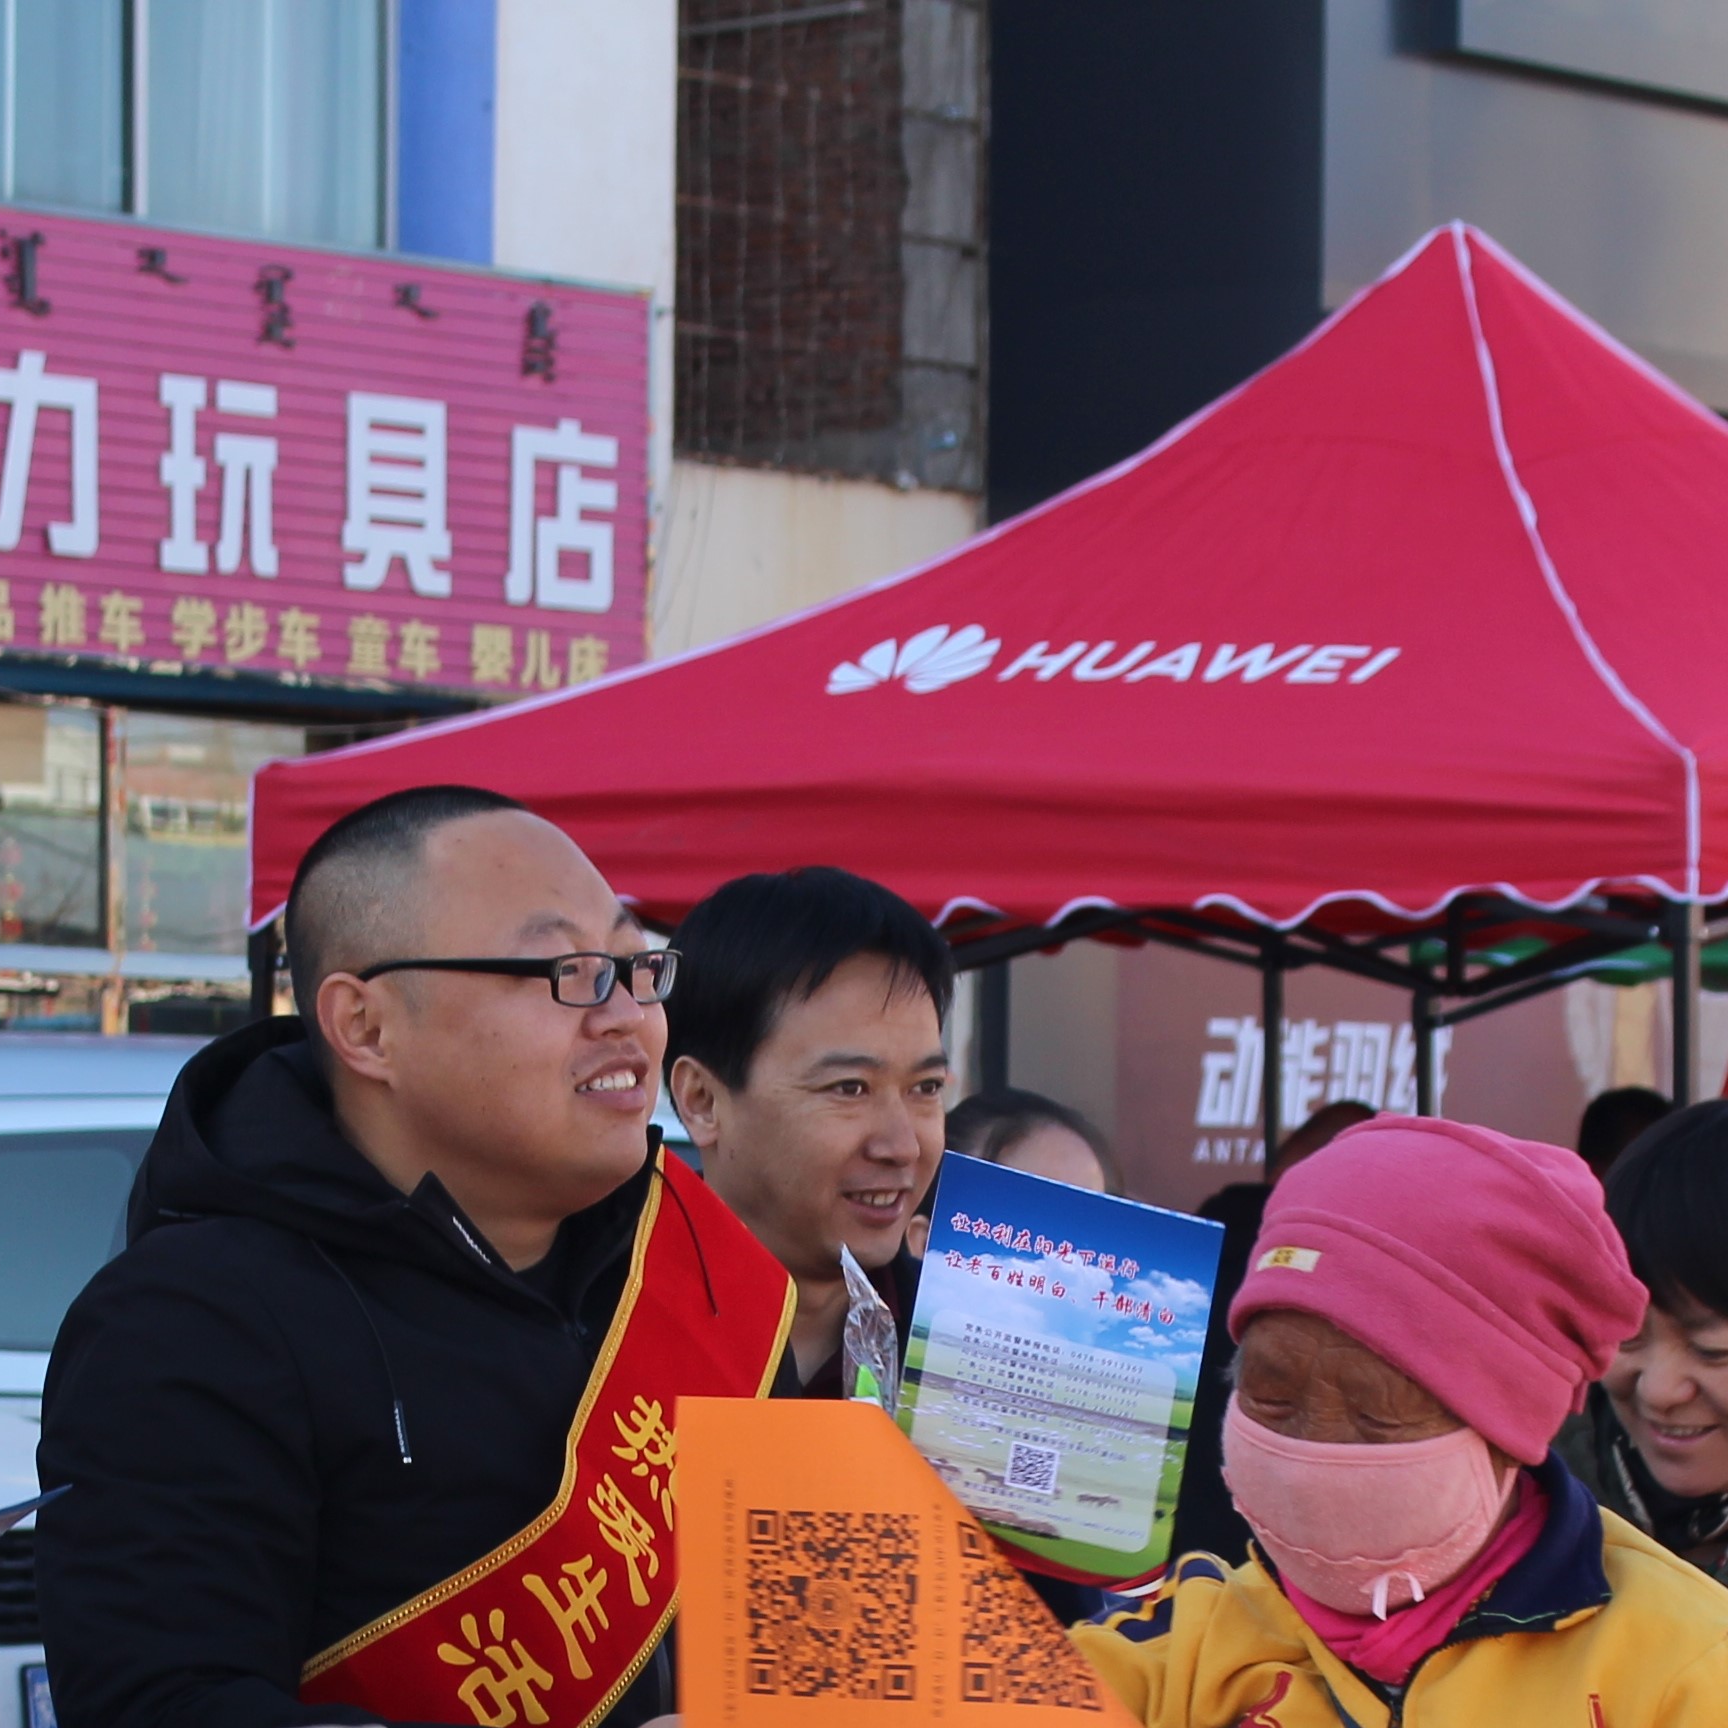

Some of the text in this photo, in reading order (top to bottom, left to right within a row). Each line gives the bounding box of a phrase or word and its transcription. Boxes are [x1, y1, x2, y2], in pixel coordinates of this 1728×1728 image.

[39, 585, 144, 653] 推车
[171, 596, 320, 669] 学步车
[347, 613, 439, 674] 童车
[997, 640, 1401, 684] HUAWEI
